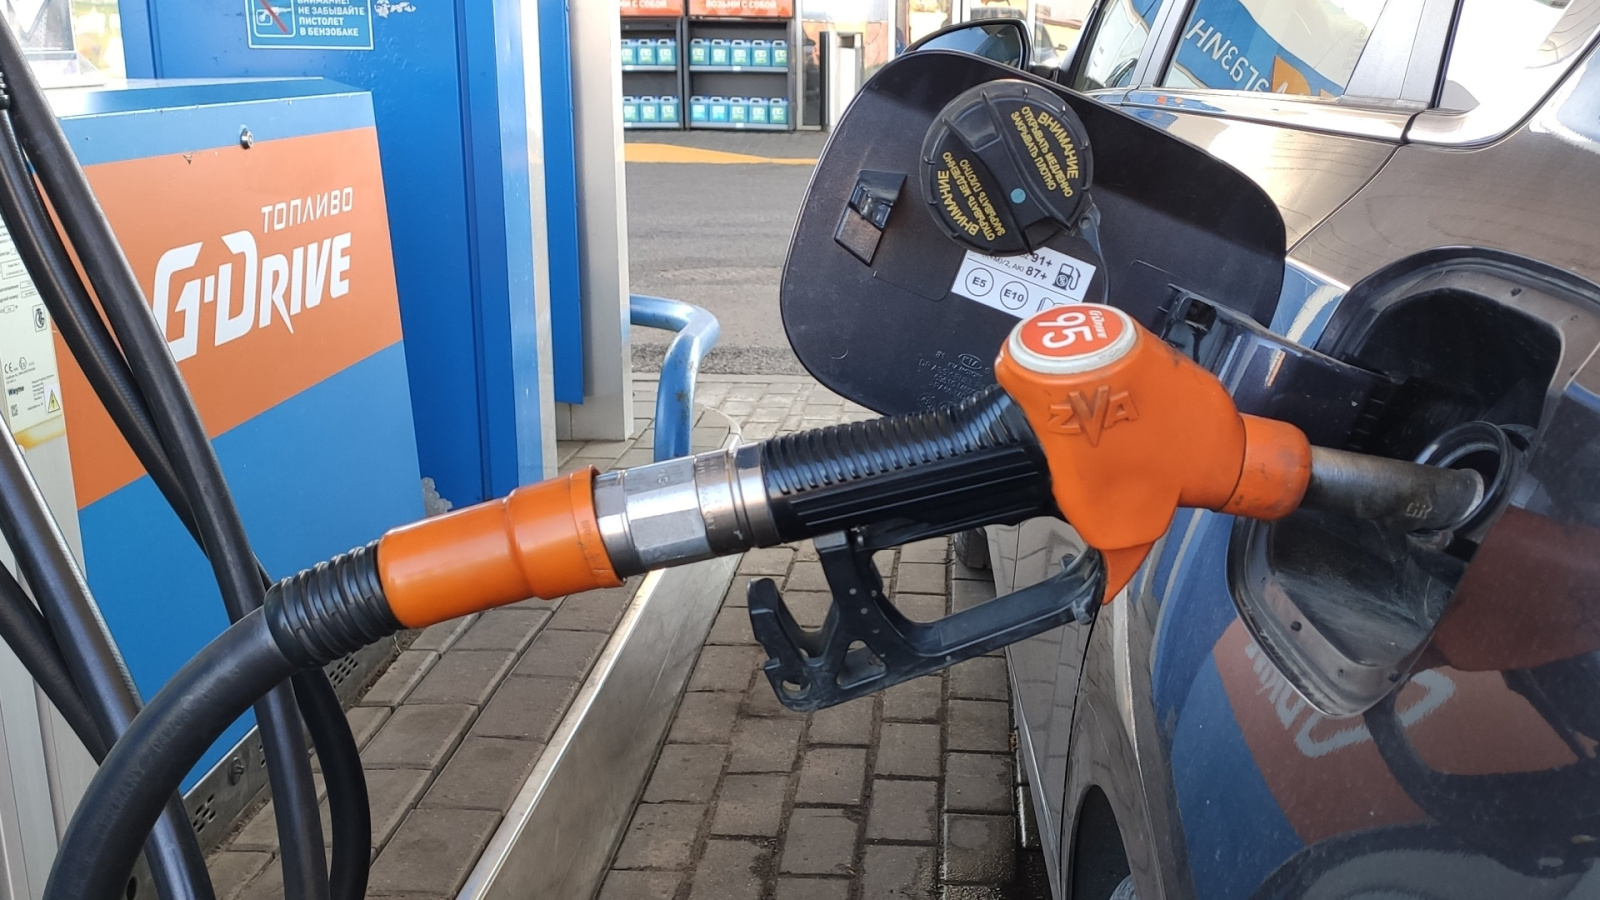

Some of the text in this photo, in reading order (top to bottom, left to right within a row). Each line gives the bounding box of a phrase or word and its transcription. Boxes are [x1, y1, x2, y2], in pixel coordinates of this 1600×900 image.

[298, 5, 365, 16] НЕ ЗАБЫВАЙТЕ
[299, 16, 344, 26] ПИСТОЛЕТ
[300, 27, 359, 37] В БЕНЗОБАКЕ
[1010, 111, 1057, 191] ЗАКРЫВАТЬ ПЛОТНО
[1021, 106, 1074, 198] ОТКРЫВАТЬ МЕДЛЕННО
[1037, 111, 1079, 179] ВНИМАНИЕ
[260, 186, 353, 234] ТОПЛИВО
[937, 170, 980, 236] ВНИМАНИЕ
[942, 151, 996, 241] ОТКРЫВАТЬ МЕДЛЕННО
[959, 159, 1006, 236] ЗАКРЫВАТЬ ПЛОТНО
[1025, 265, 1048, 281] 87+
[1030, 252, 1053, 267] 91+
[972, 276, 988, 288] E5
[1003, 288, 1025, 303] E10
[1036, 311, 1094, 350] 95
